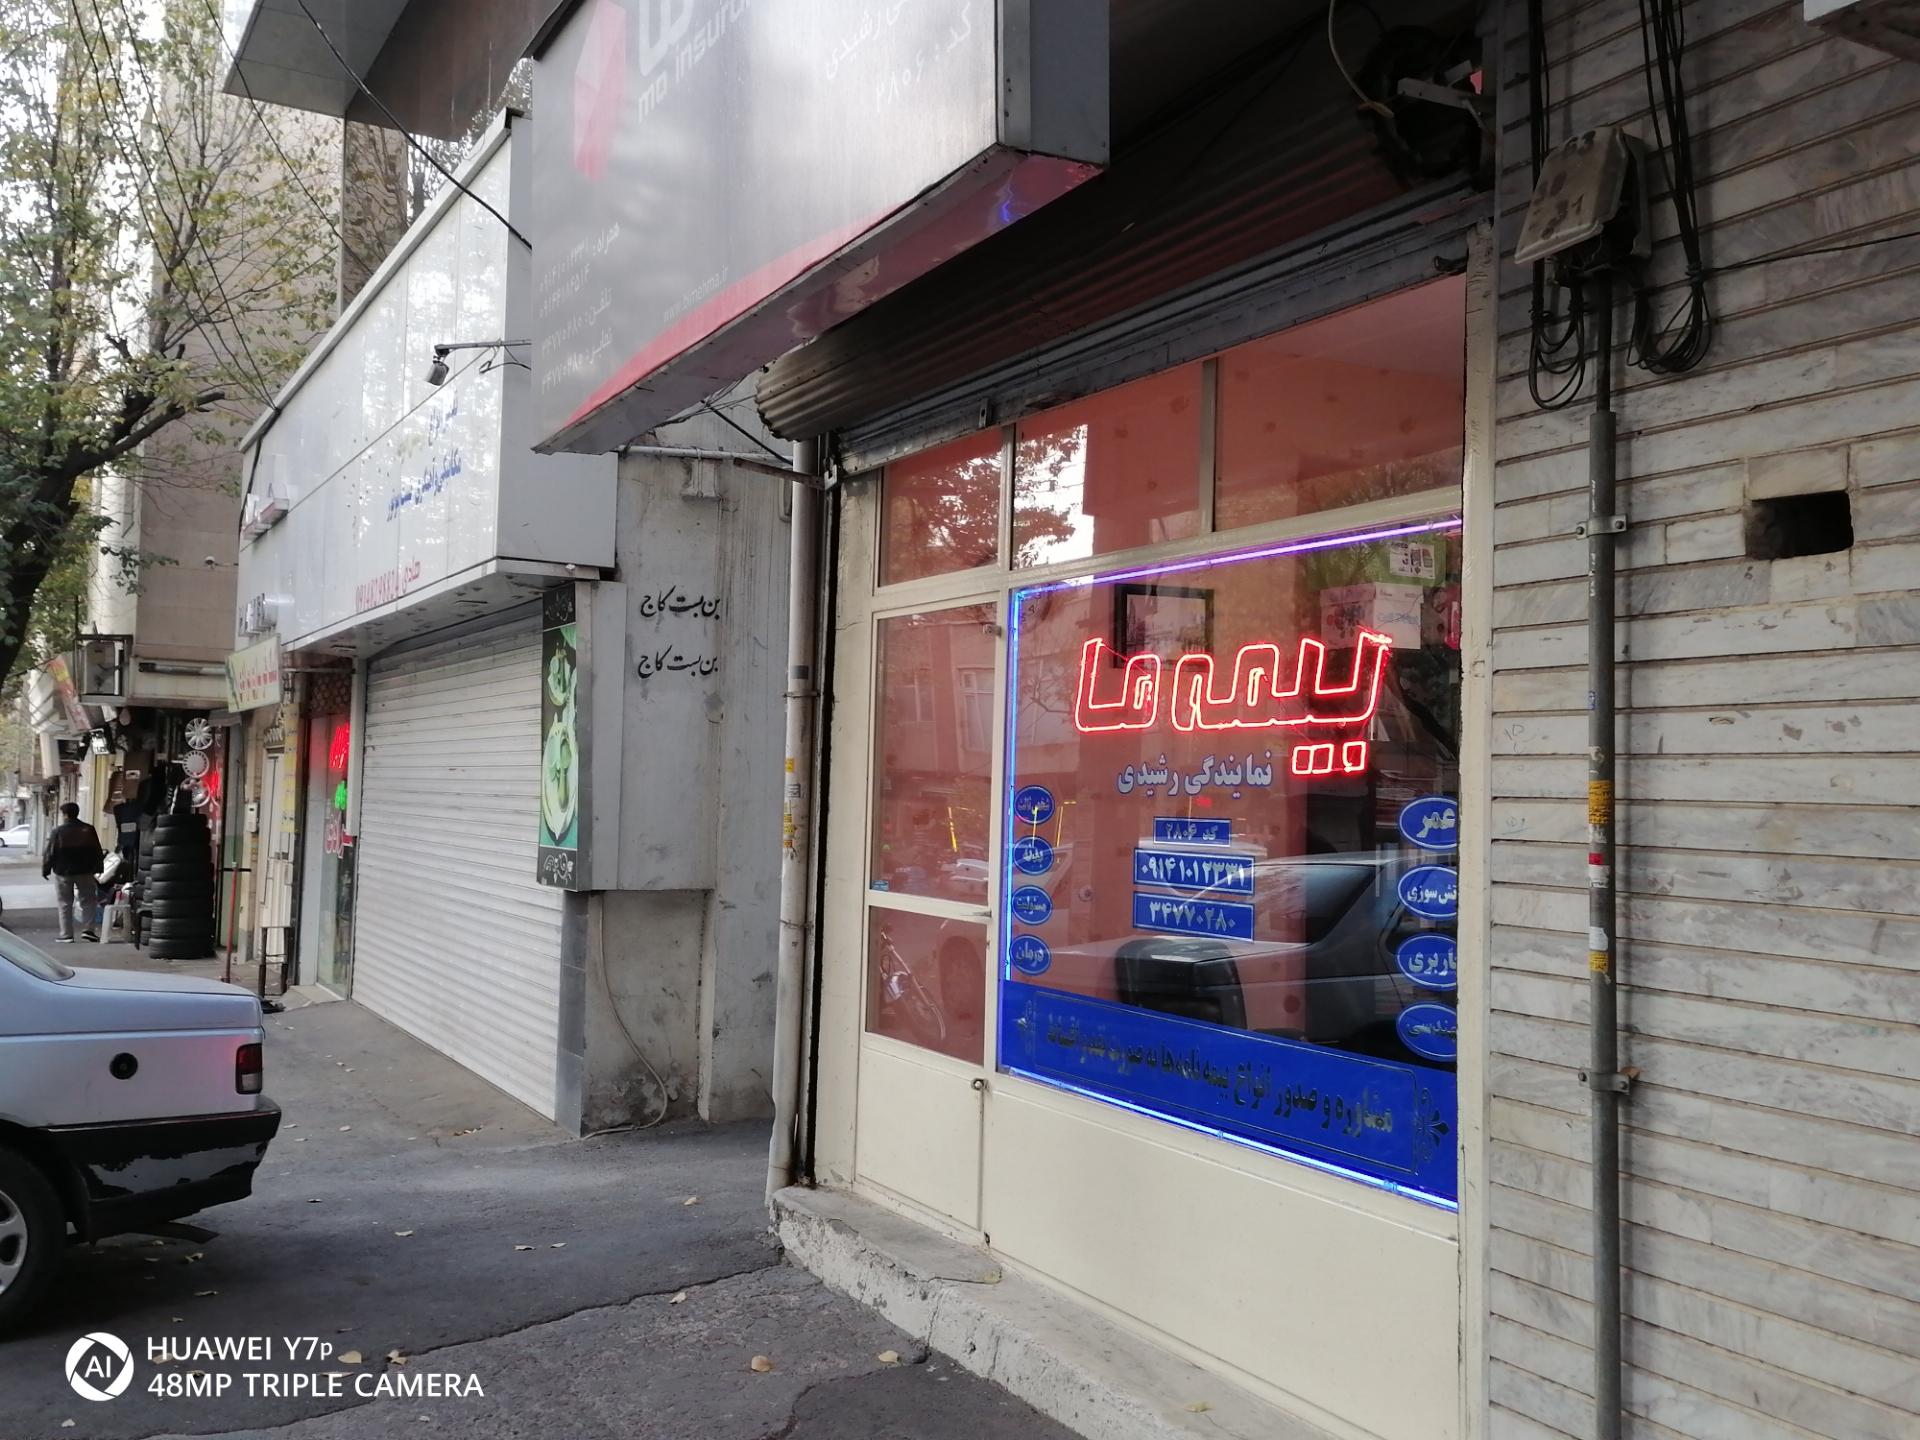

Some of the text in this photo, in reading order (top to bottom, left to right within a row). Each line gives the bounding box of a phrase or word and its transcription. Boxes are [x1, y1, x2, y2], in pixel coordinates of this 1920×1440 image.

[639, 69, 668, 124] ma
[641, 585, 676, 617] کاج
[638, 645, 672, 679] کاج
[1075, 630, 1393, 776] بیمه ما
[1116, 749, 1274, 800] نمایندگی رشیدی
[1165, 822, 1219, 841] کد ۲۸۰۶
[1416, 807, 1456, 839] عمر
[1407, 884, 1457, 905] تش سوزی
[1149, 900, 1237, 932] ۳۴۷۷۰۲۸۰
[1015, 941, 1045, 967] درمان
[1234, 1060, 1271, 1110] انواع
[1273, 1084, 1318, 1119] صدور
[1321, 1093, 1331, 1129] و
[1335, 1086, 1393, 1138] مشاوره
